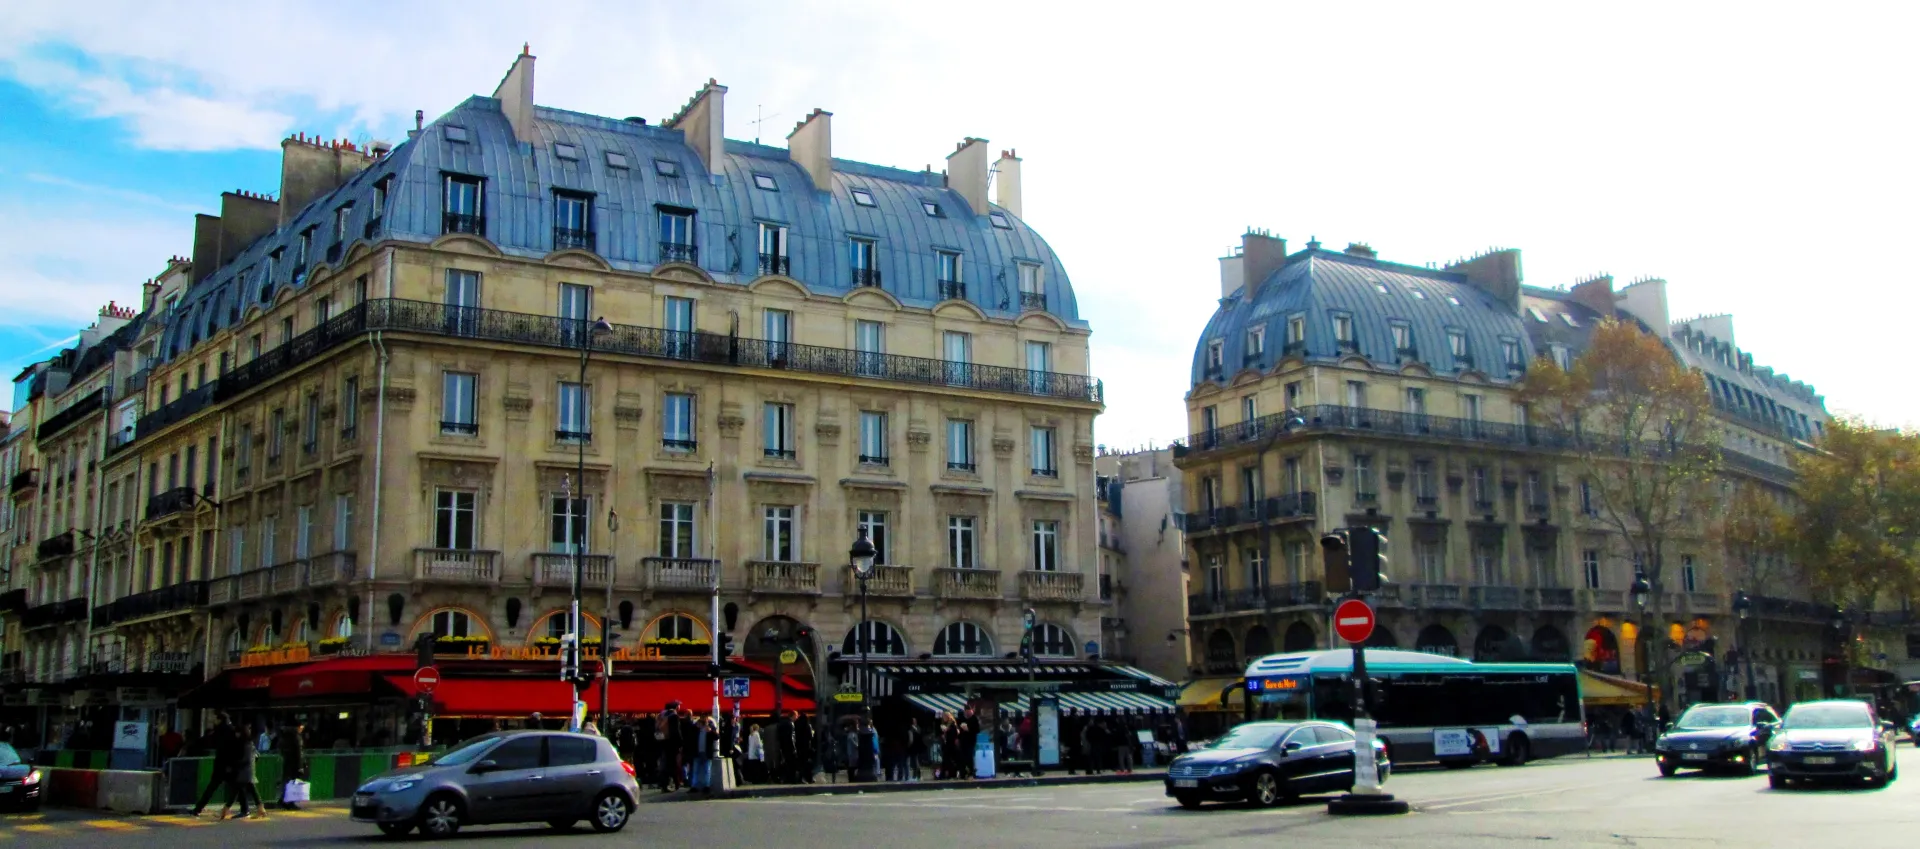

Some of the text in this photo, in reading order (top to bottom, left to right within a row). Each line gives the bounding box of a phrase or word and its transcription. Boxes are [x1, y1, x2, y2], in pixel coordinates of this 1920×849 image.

[468, 645, 485, 660] LE
[1265, 679, 1278, 689] Gare
[1284, 678, 1296, 689] Nord
